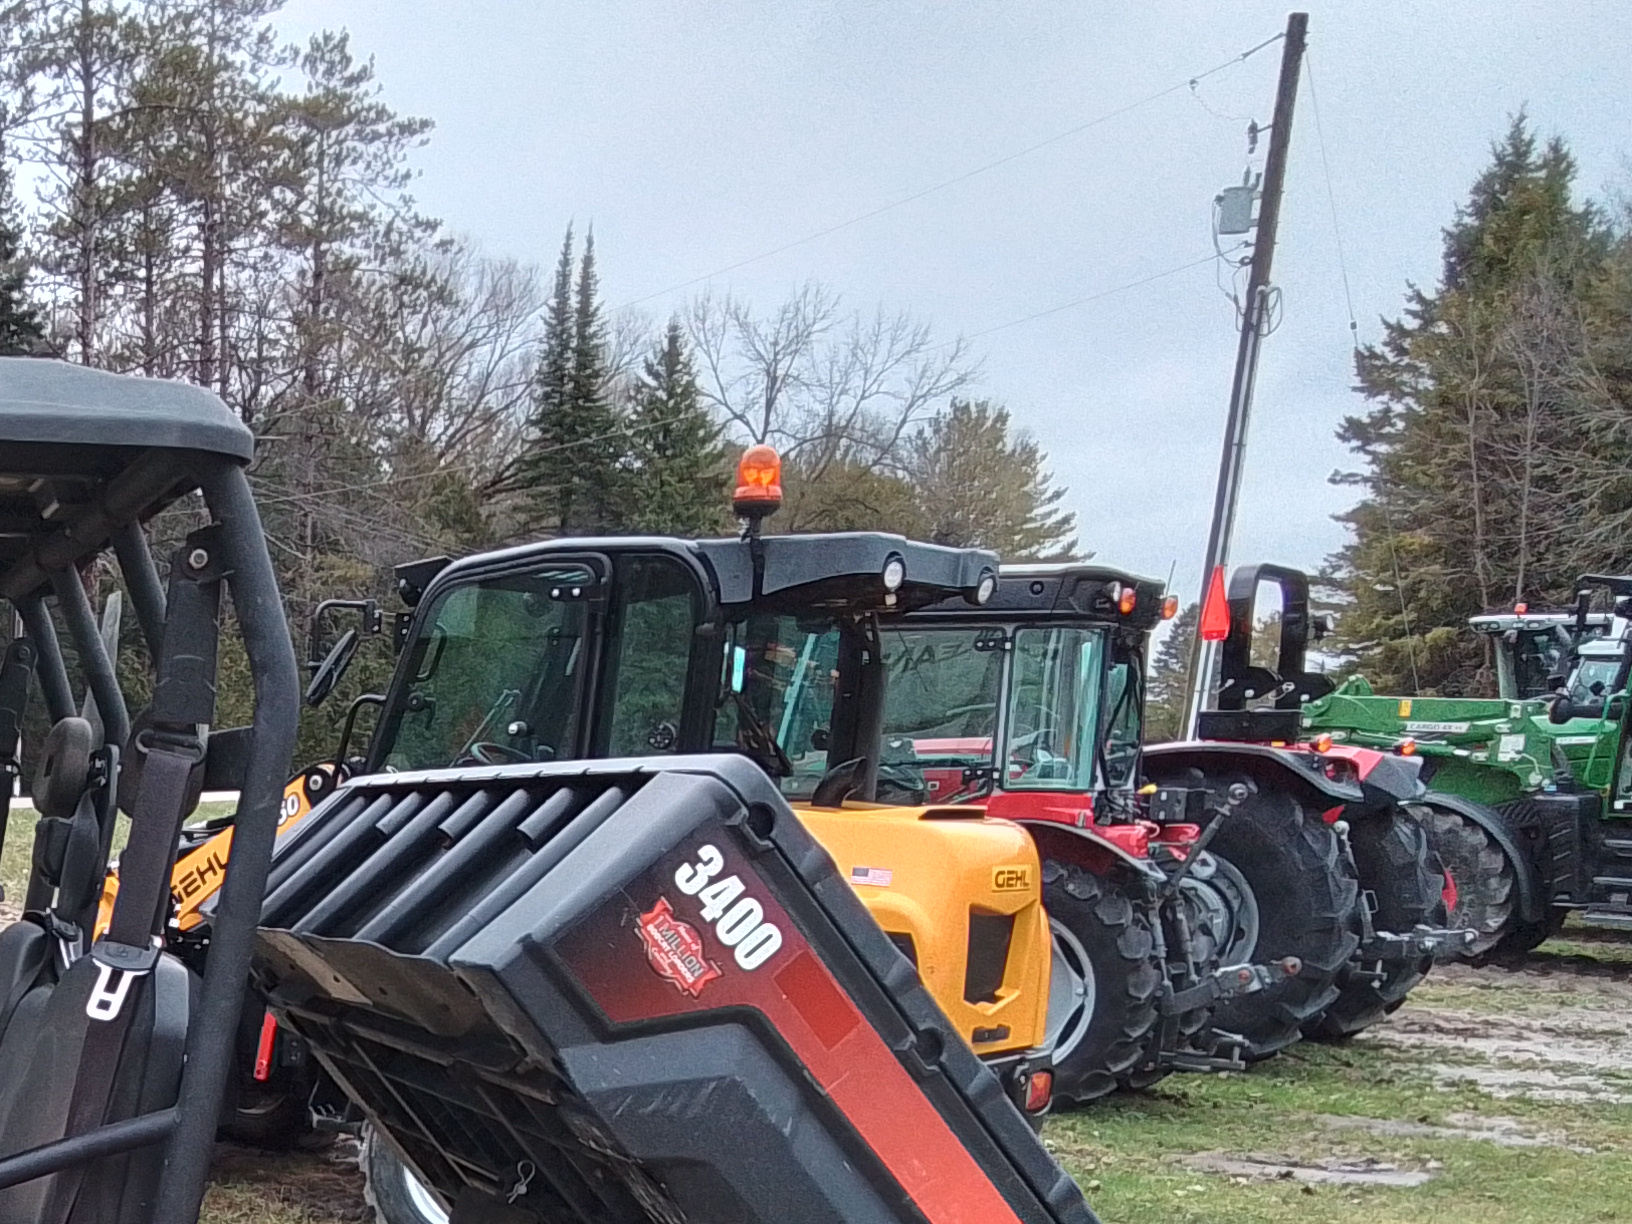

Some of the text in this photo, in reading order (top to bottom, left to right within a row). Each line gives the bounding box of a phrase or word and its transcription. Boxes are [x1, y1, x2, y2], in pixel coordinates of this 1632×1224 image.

[995, 869, 1030, 889] GEHL
[675, 844, 782, 970] 3400
[657, 922, 706, 977] MILLION
